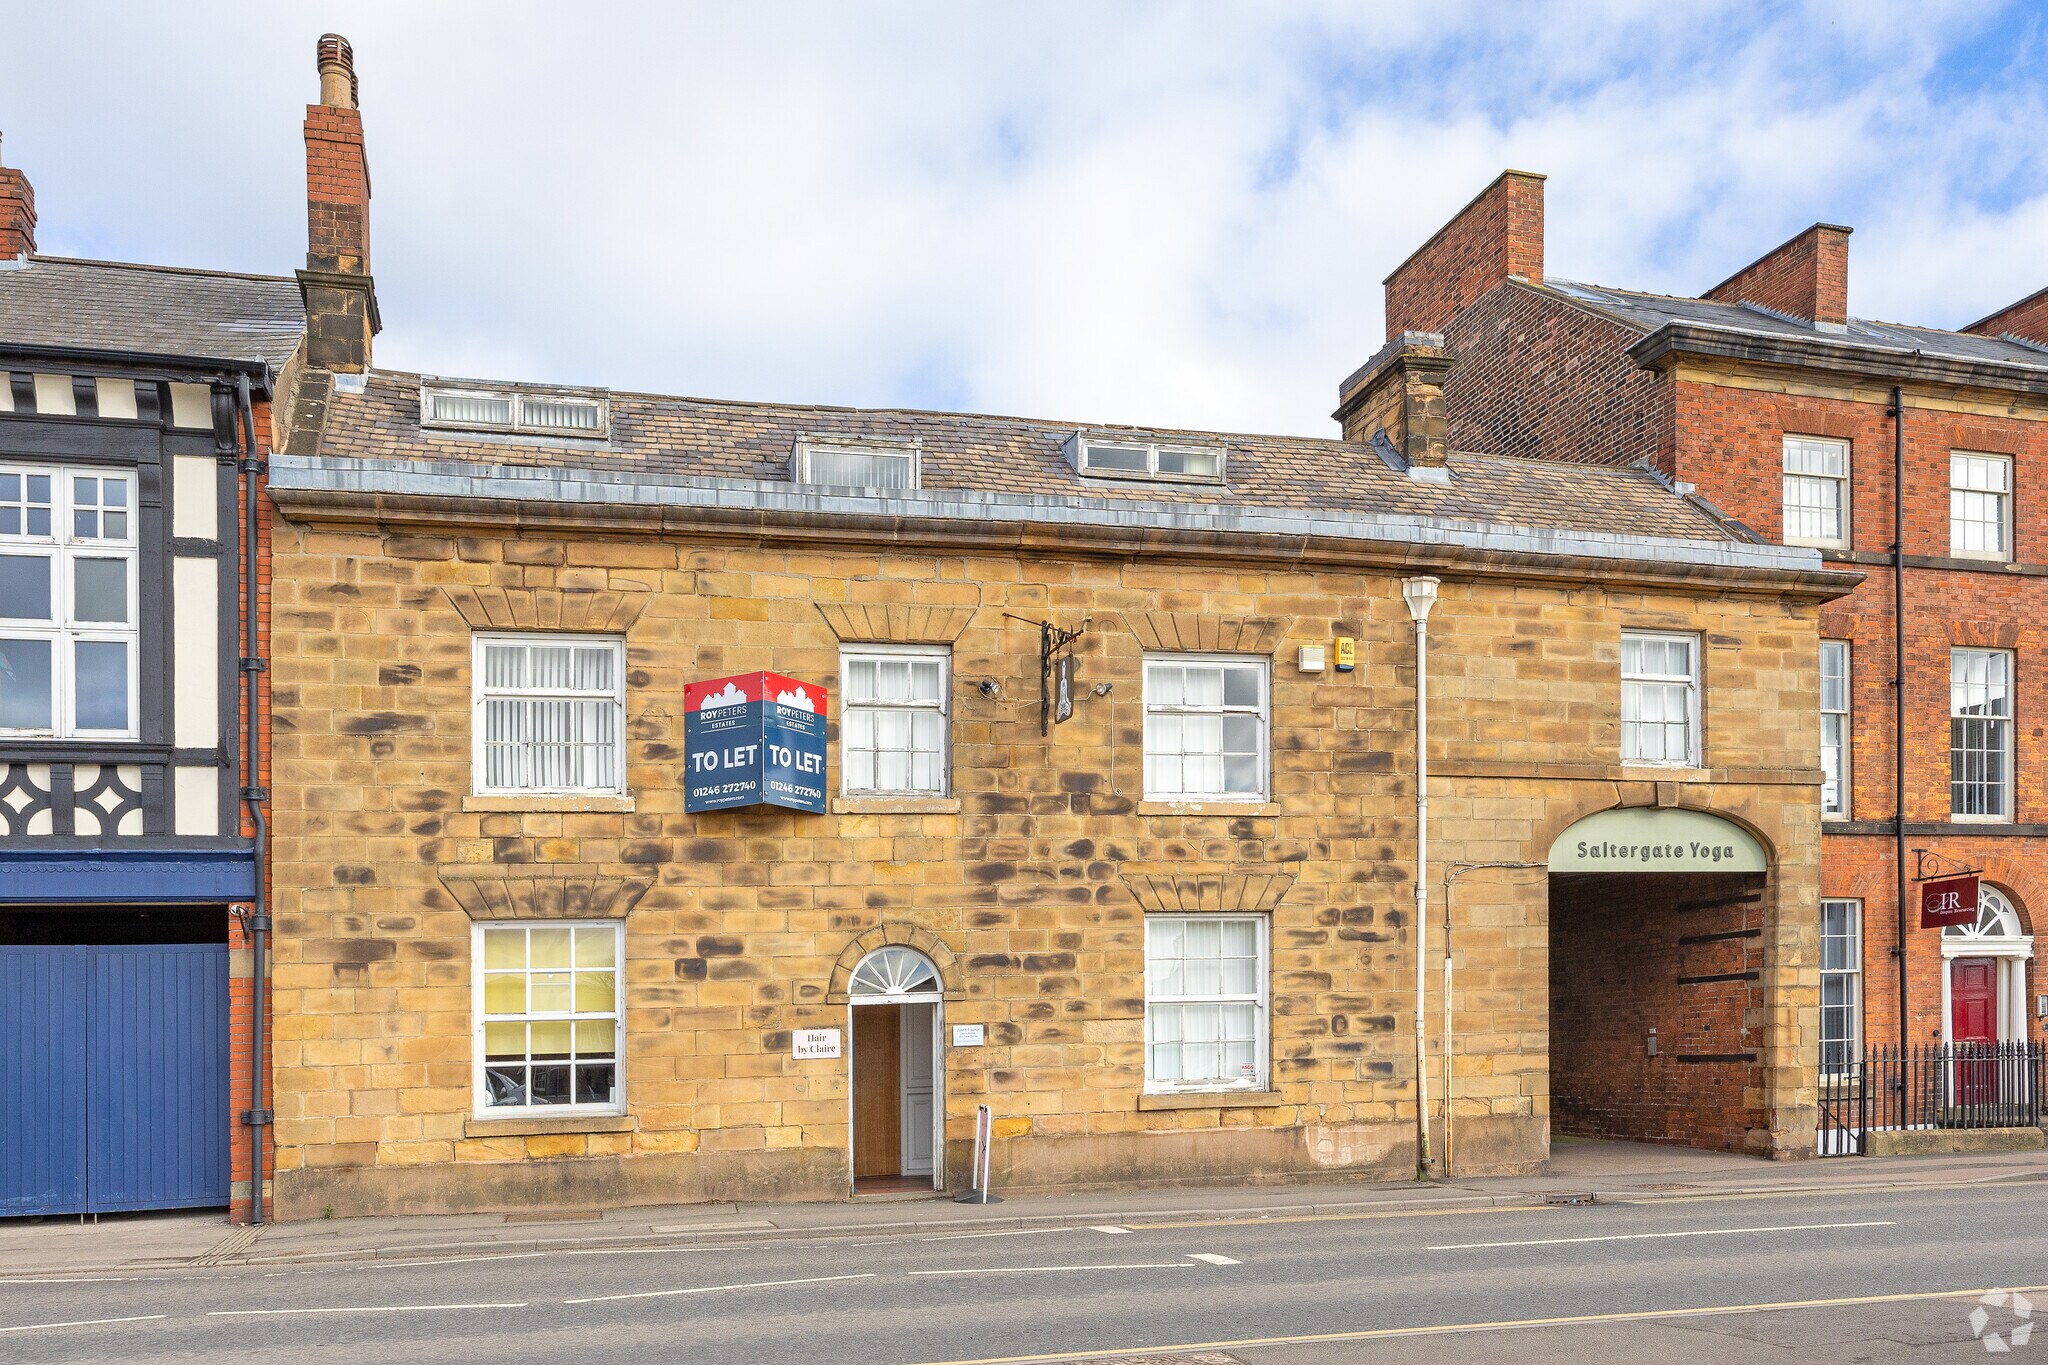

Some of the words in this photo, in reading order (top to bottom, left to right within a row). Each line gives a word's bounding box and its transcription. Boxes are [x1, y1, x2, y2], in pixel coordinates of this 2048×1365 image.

[1341, 642, 1353, 654] ACE
[711, 720, 736, 729] ESTATES
[786, 721, 806, 731] ESTATES
[692, 751, 719, 773] TO
[723, 744, 758, 769] LET
[769, 744, 792, 768] TO
[795, 750, 823, 775] LET
[693, 785, 720, 798] 01246
[722, 780, 756, 794] 272740
[770, 780, 793, 794] 01246
[794, 785, 821, 799] 272740
[704, 795, 745, 805] www.roypeters.com
[1577, 841, 1684, 862] Saltergate
[1690, 842, 1734, 863] Yoga
[806, 1034, 827, 1043] Hair
[797, 1046, 808, 1055] by
[809, 1044, 836, 1054] Claire
